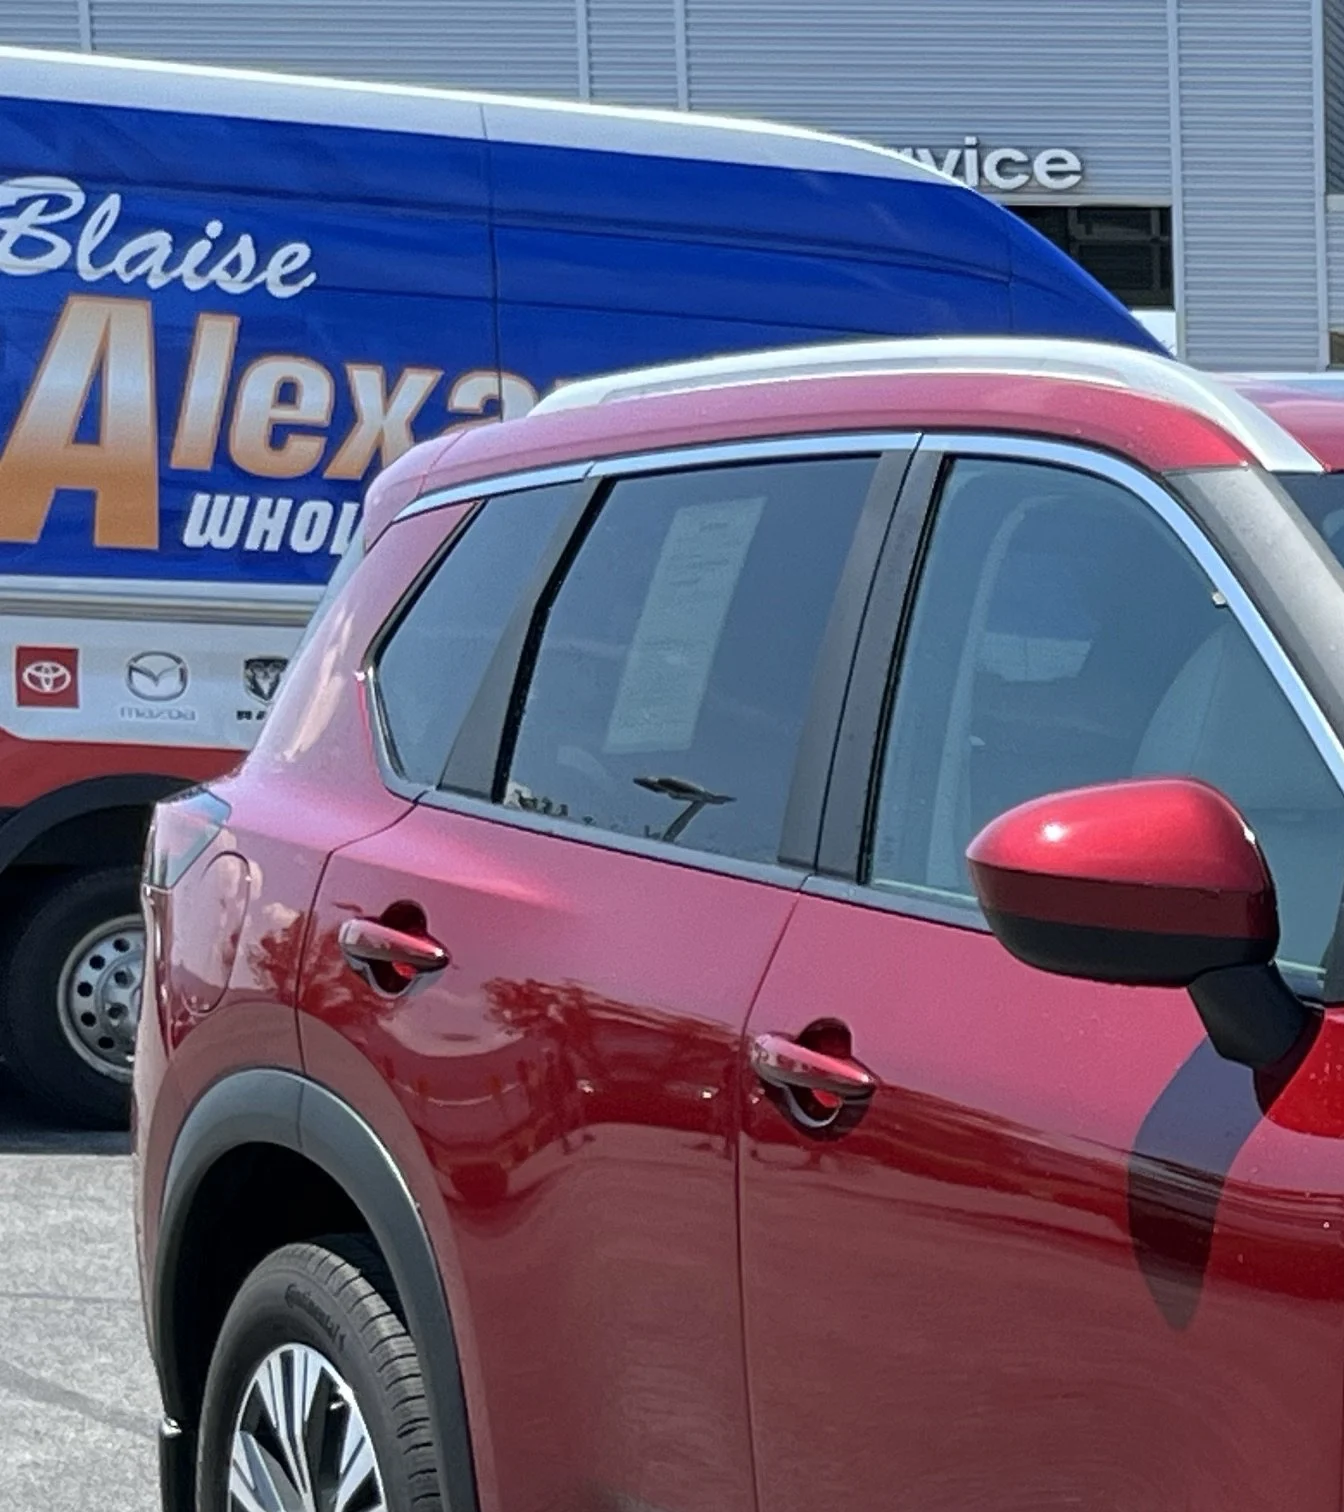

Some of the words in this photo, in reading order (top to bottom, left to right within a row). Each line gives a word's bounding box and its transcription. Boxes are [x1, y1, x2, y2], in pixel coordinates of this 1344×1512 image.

[903, 135, 1083, 190] vice
[0, 175, 317, 299] Blaise
[0, 293, 560, 551] Alexa
